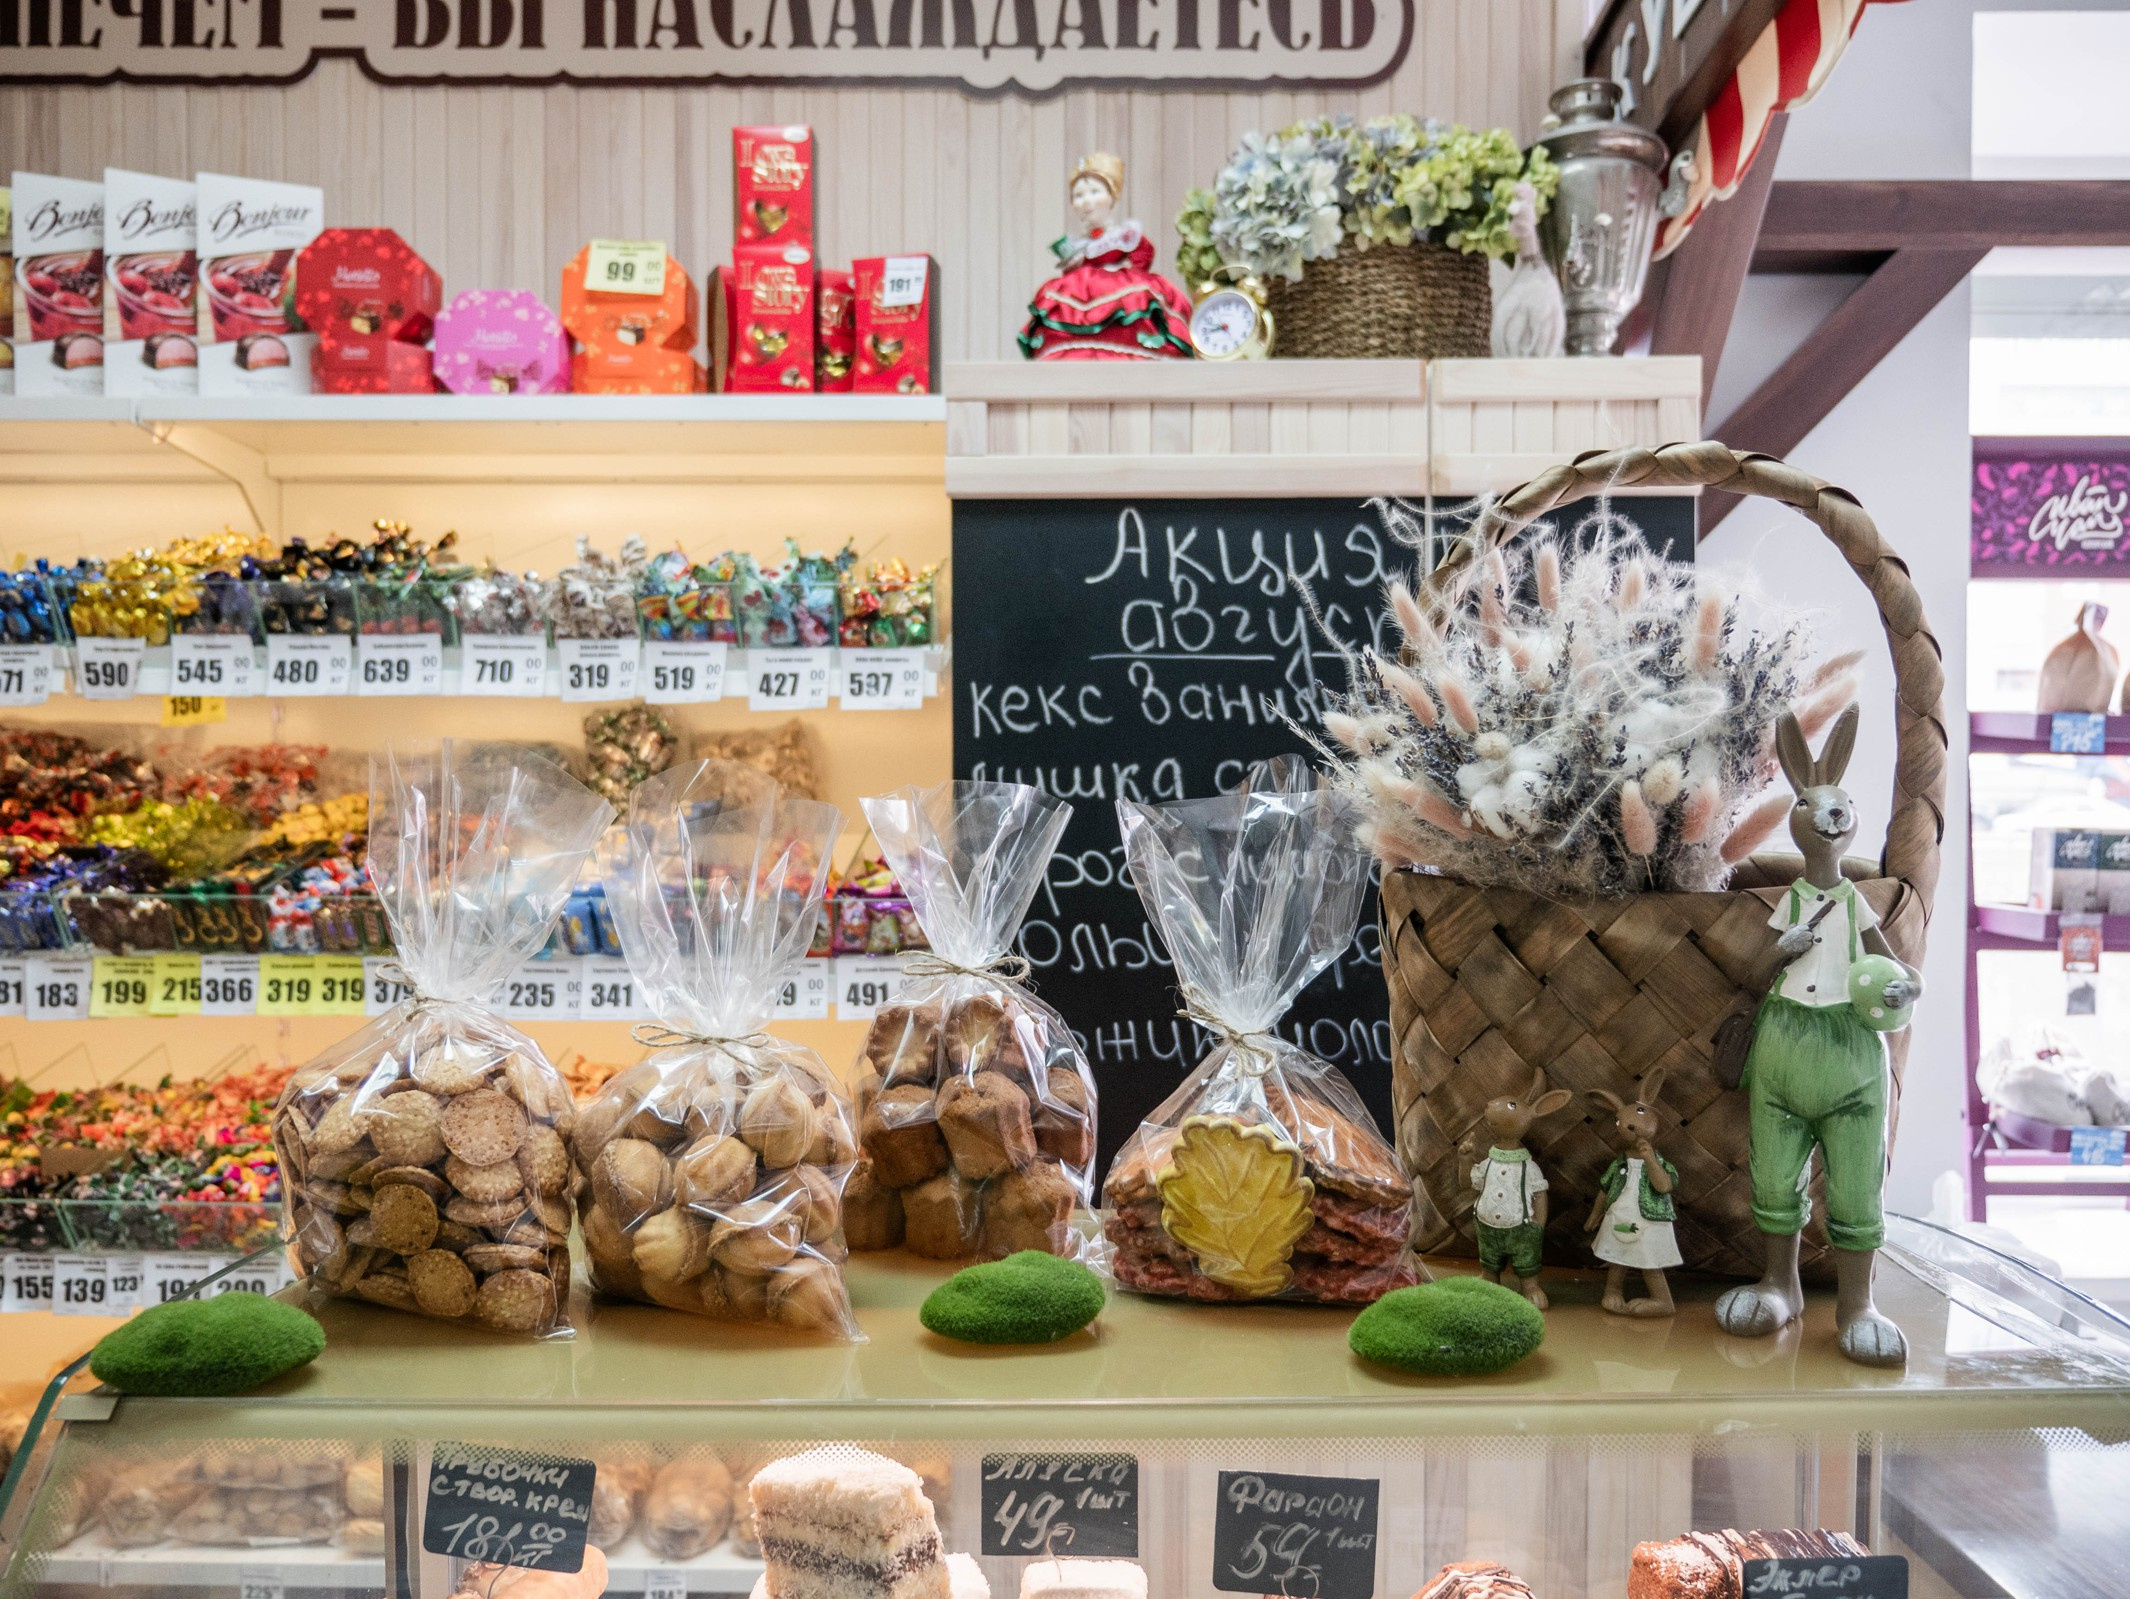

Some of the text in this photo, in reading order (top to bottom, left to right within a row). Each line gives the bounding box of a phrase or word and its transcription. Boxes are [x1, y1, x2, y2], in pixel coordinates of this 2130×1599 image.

[607, 261, 636, 281] 99
[1085, 506, 1400, 597] Акция
[0, 669, 23, 693] 71
[85, 662, 128, 687] 590
[178, 659, 223, 683] 545
[273, 660, 319, 683] 480
[364, 659, 410, 683] 639
[475, 660, 514, 683] 710
[569, 664, 609, 688] 319
[654, 667, 695, 690] 519
[759, 673, 800, 697] 427
[36, 983, 78, 1007] 183
[102, 980, 146, 1003] 199
[163, 977, 201, 1001] 215
[205, 978, 252, 1002] 366
[267, 979, 310, 1002] 319
[322, 978, 364, 1001] 319
[509, 983, 555, 1007] 235
[591, 983, 634, 1007] 341
[776, 981, 797, 1006] 9
[845, 981, 889, 1007] 491
[13, 1276, 53, 1299] 155
[62, 1279, 105, 1303] 139
[112, 1276, 138, 1292] 123
